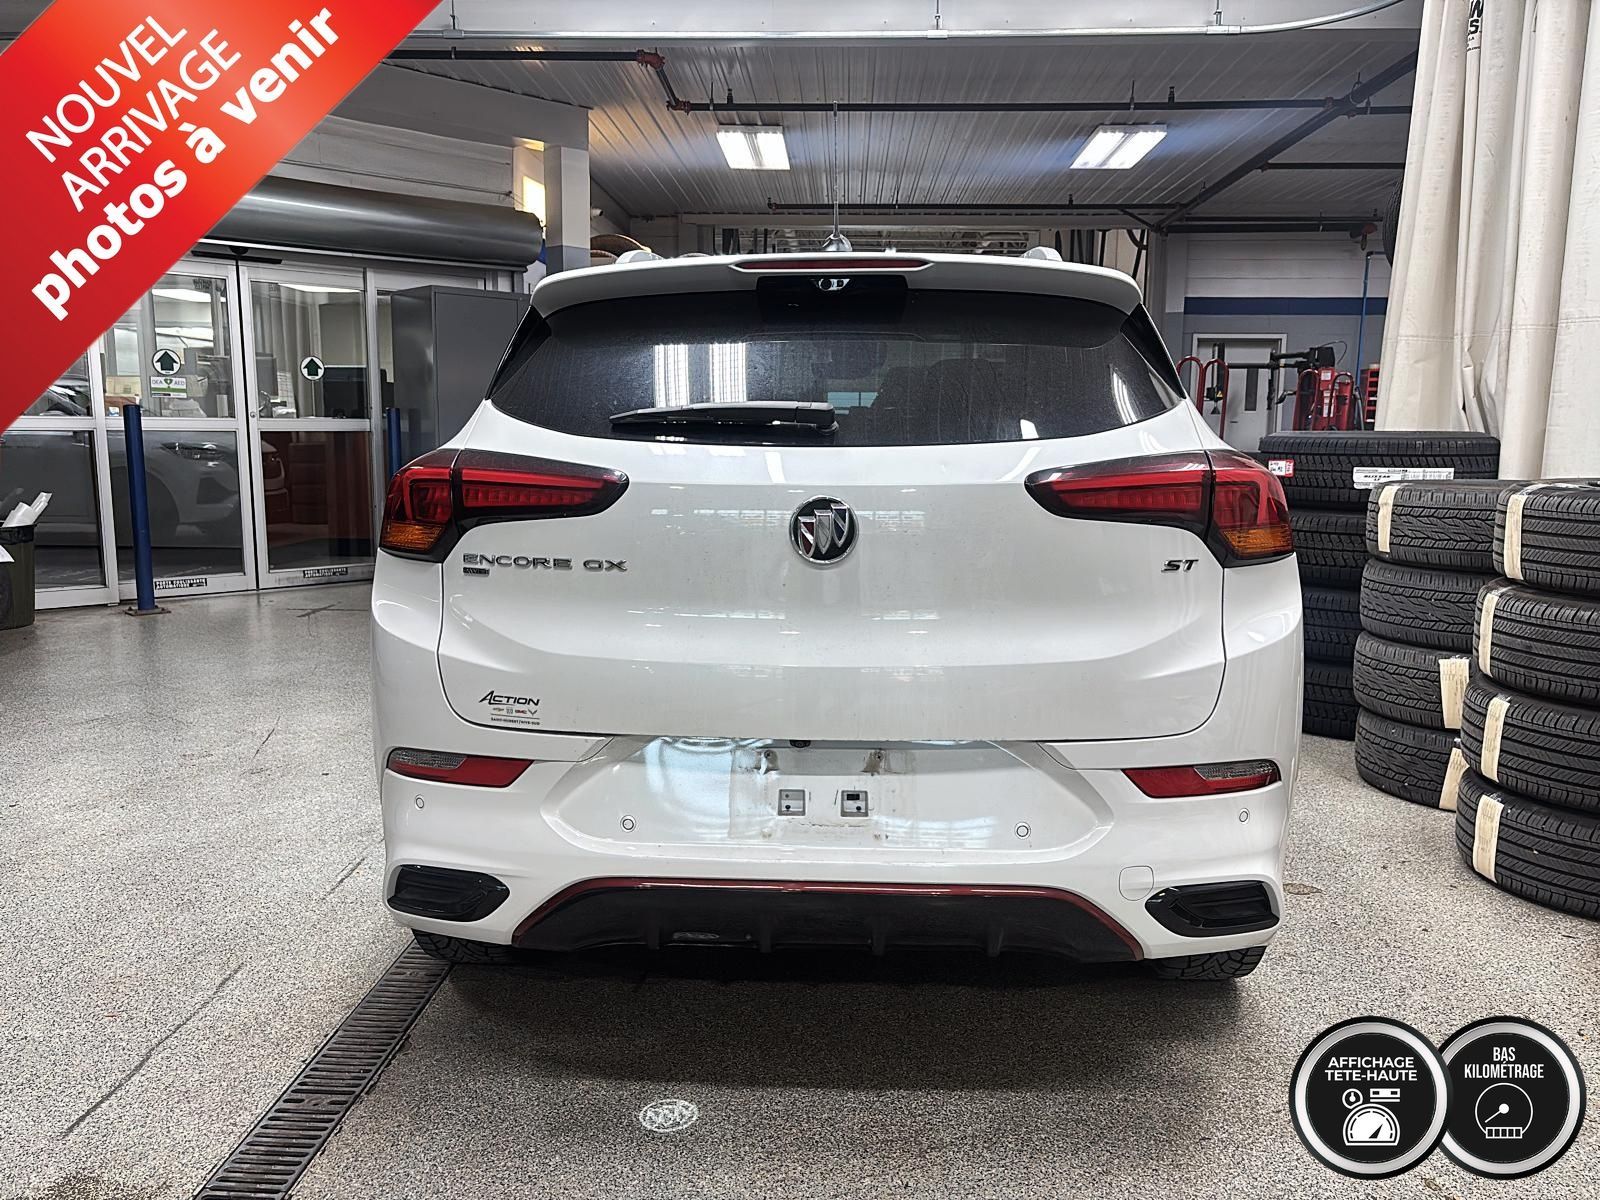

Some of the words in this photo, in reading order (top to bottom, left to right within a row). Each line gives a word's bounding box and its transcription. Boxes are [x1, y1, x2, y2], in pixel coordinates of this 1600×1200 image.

[463, 553, 572, 570] ENCORE
[583, 559, 628, 572] GX
[1161, 559, 1199, 572] ST
[479, 690, 540, 706] ACTION
